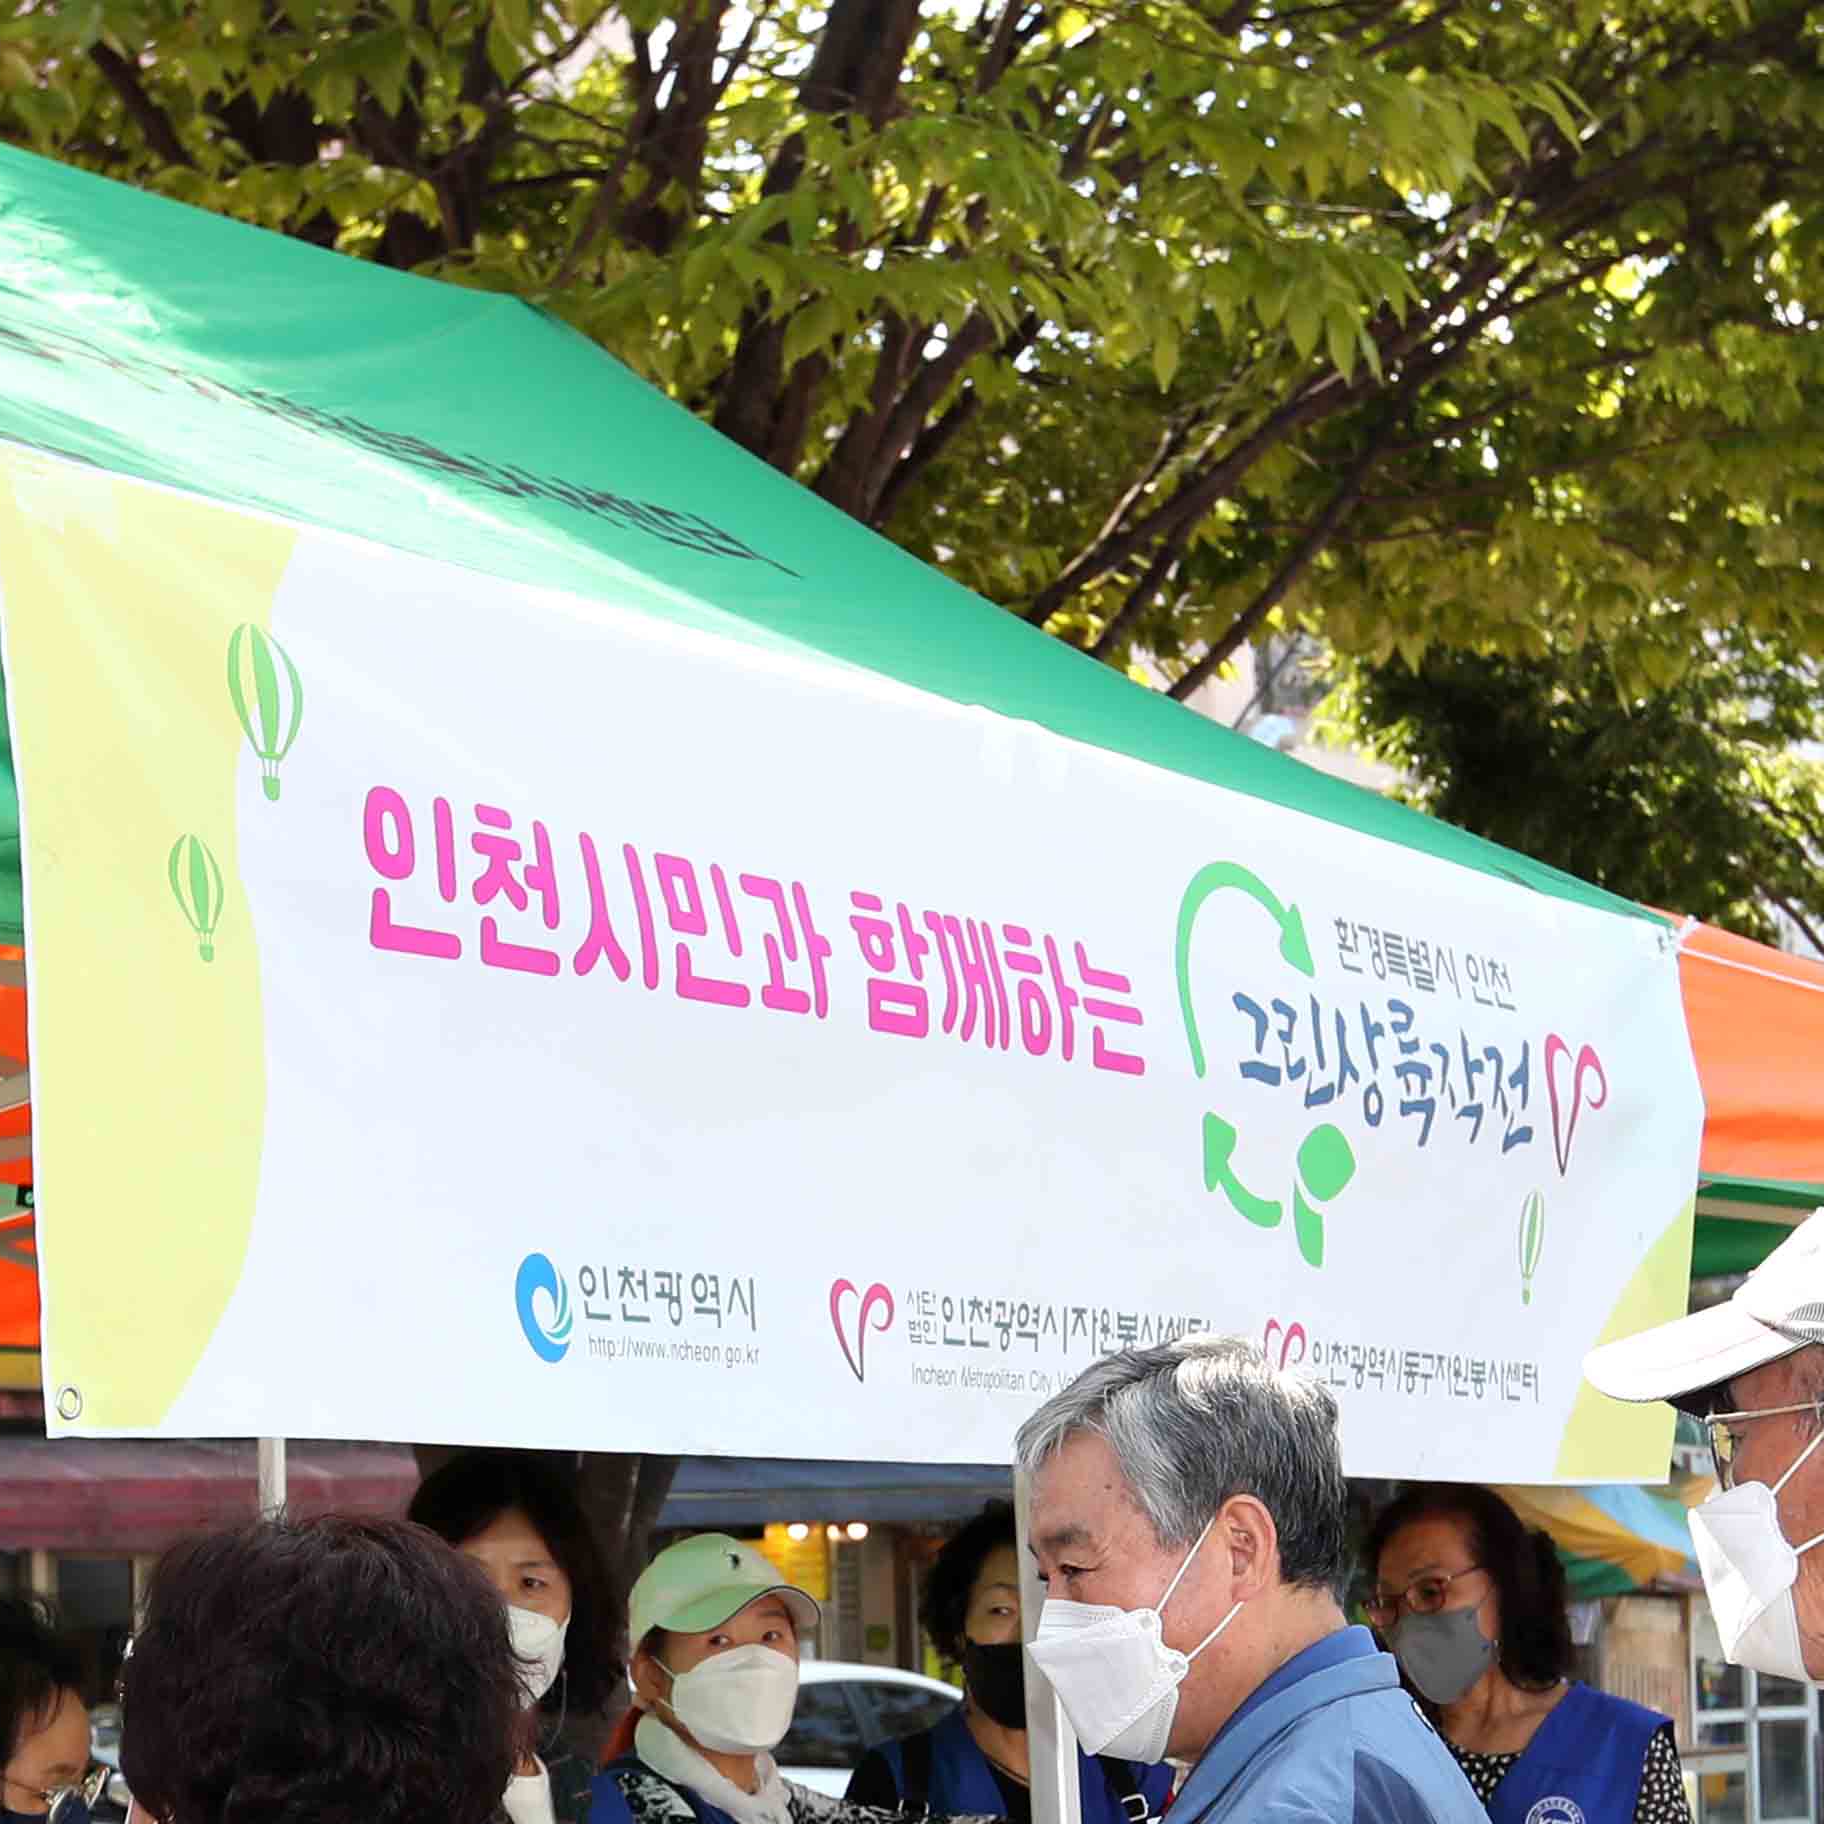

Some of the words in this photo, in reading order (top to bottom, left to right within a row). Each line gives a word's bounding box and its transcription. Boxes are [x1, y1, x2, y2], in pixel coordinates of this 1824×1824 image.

[363, 785, 831, 1020] 인천시민과
[848, 888, 1145, 1077] 함께하는
[1334, 916, 1461, 998] 환경특별시
[1465, 951, 1517, 1012] 인천
[1232, 991, 1534, 1155] 그린상륙작전
[578, 1264, 757, 1332] 인천광역시
[911, 1362, 957, 1387] Incheon
